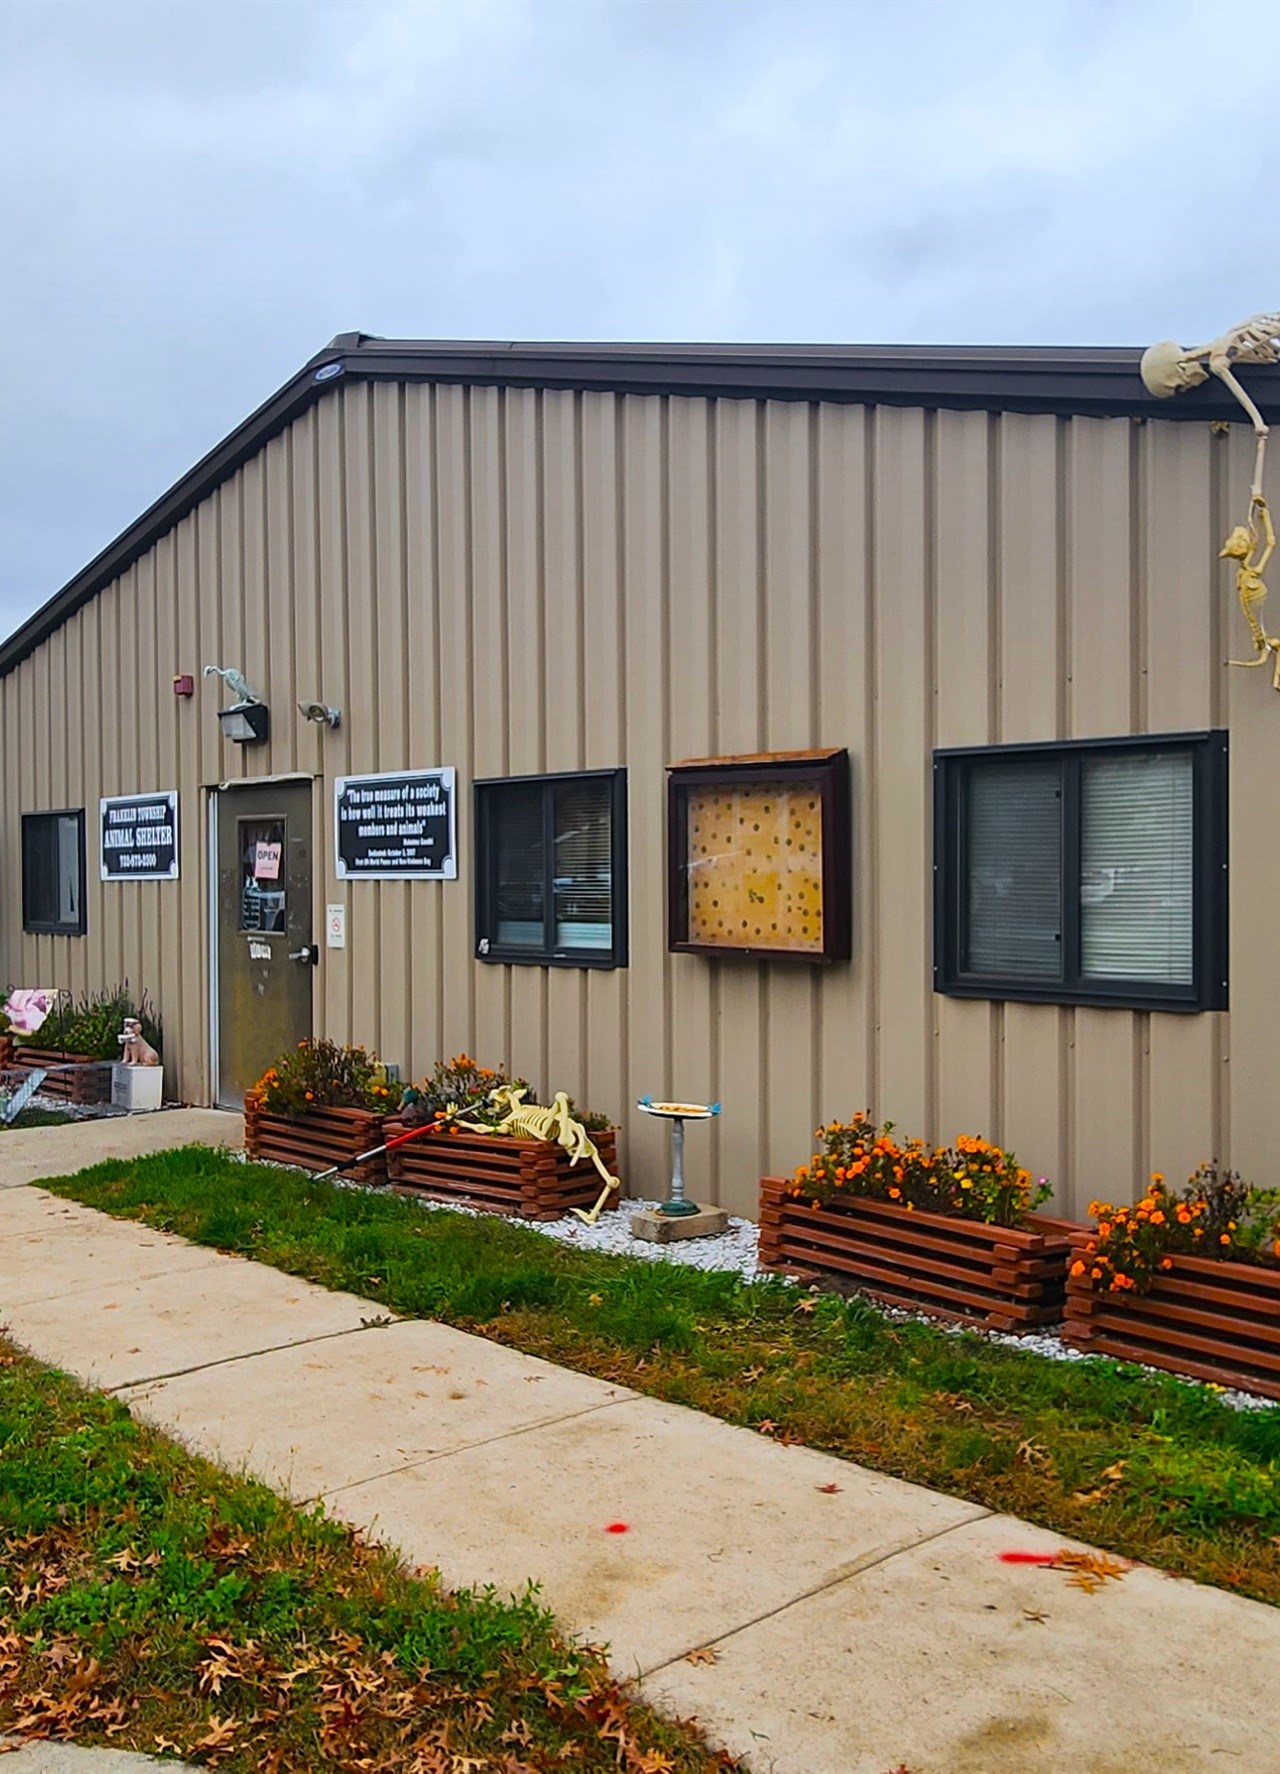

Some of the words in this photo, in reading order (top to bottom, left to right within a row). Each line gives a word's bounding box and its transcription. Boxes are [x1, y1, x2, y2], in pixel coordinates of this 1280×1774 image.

[361, 789, 373, 802] true
[375, 788, 400, 802] measure
[402, 784, 409, 800] of
[410, 787, 415, 799] a
[416, 783, 440, 801] society
[348, 807, 361, 820] how
[363, 805, 376, 820] well
[377, 804, 382, 819] it
[384, 804, 404, 818] treats
[406, 803, 415, 818] its
[416, 801, 446, 817] weakest
[104, 828, 134, 848] ANIMAL
[136, 825, 173, 847] SHELTER
[358, 822, 385, 837] members
[386, 821, 397, 836] and
[257, 850, 279, 860] OPEN
